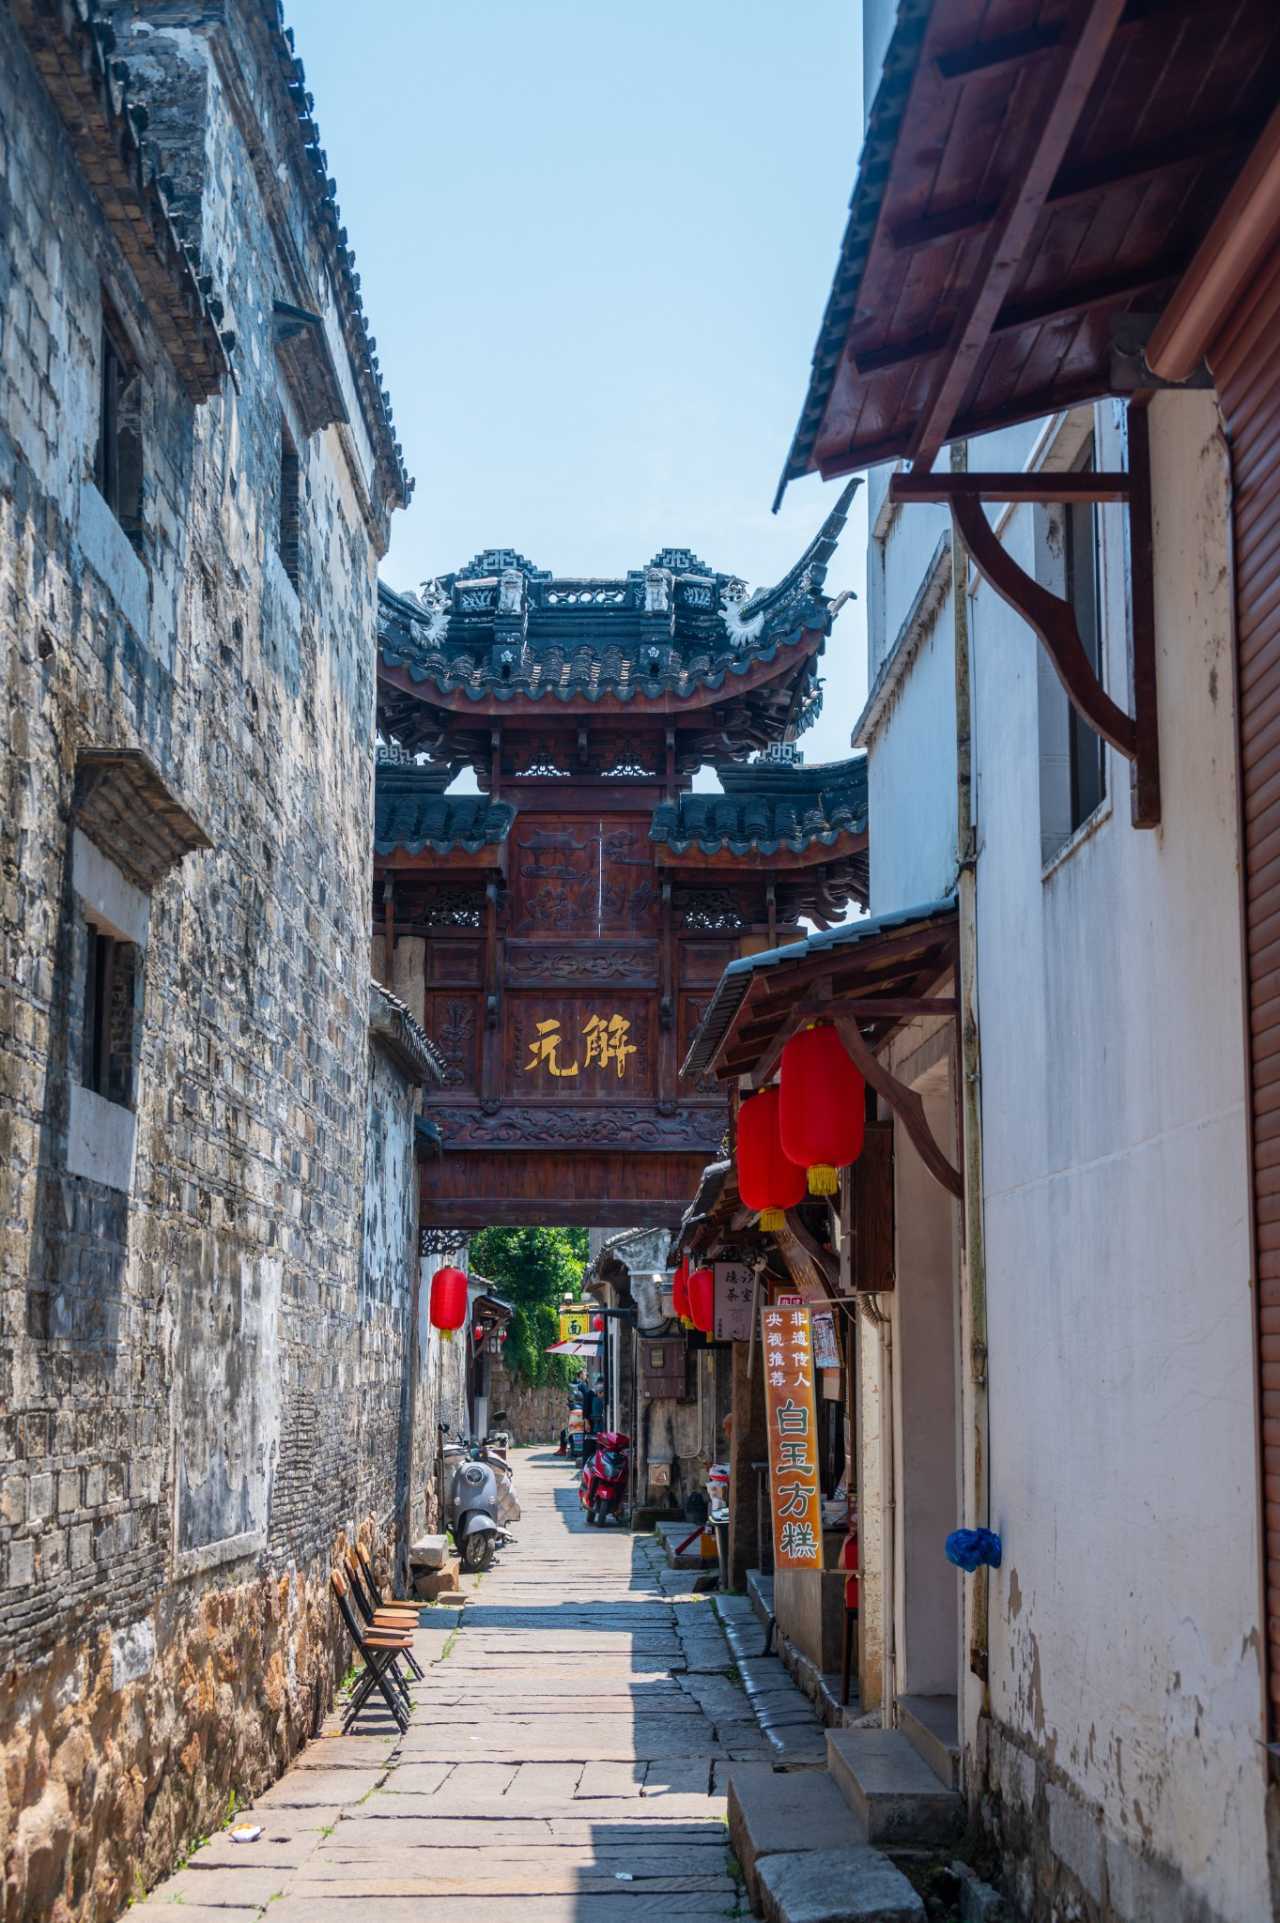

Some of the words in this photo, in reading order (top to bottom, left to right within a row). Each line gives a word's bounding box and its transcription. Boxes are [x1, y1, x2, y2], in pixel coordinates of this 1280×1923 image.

[766, 1311, 786, 1387] 央视推荐
[790, 1311, 811, 1387] 非遗传人
[776, 1399, 818, 1559] 白玉方糕
